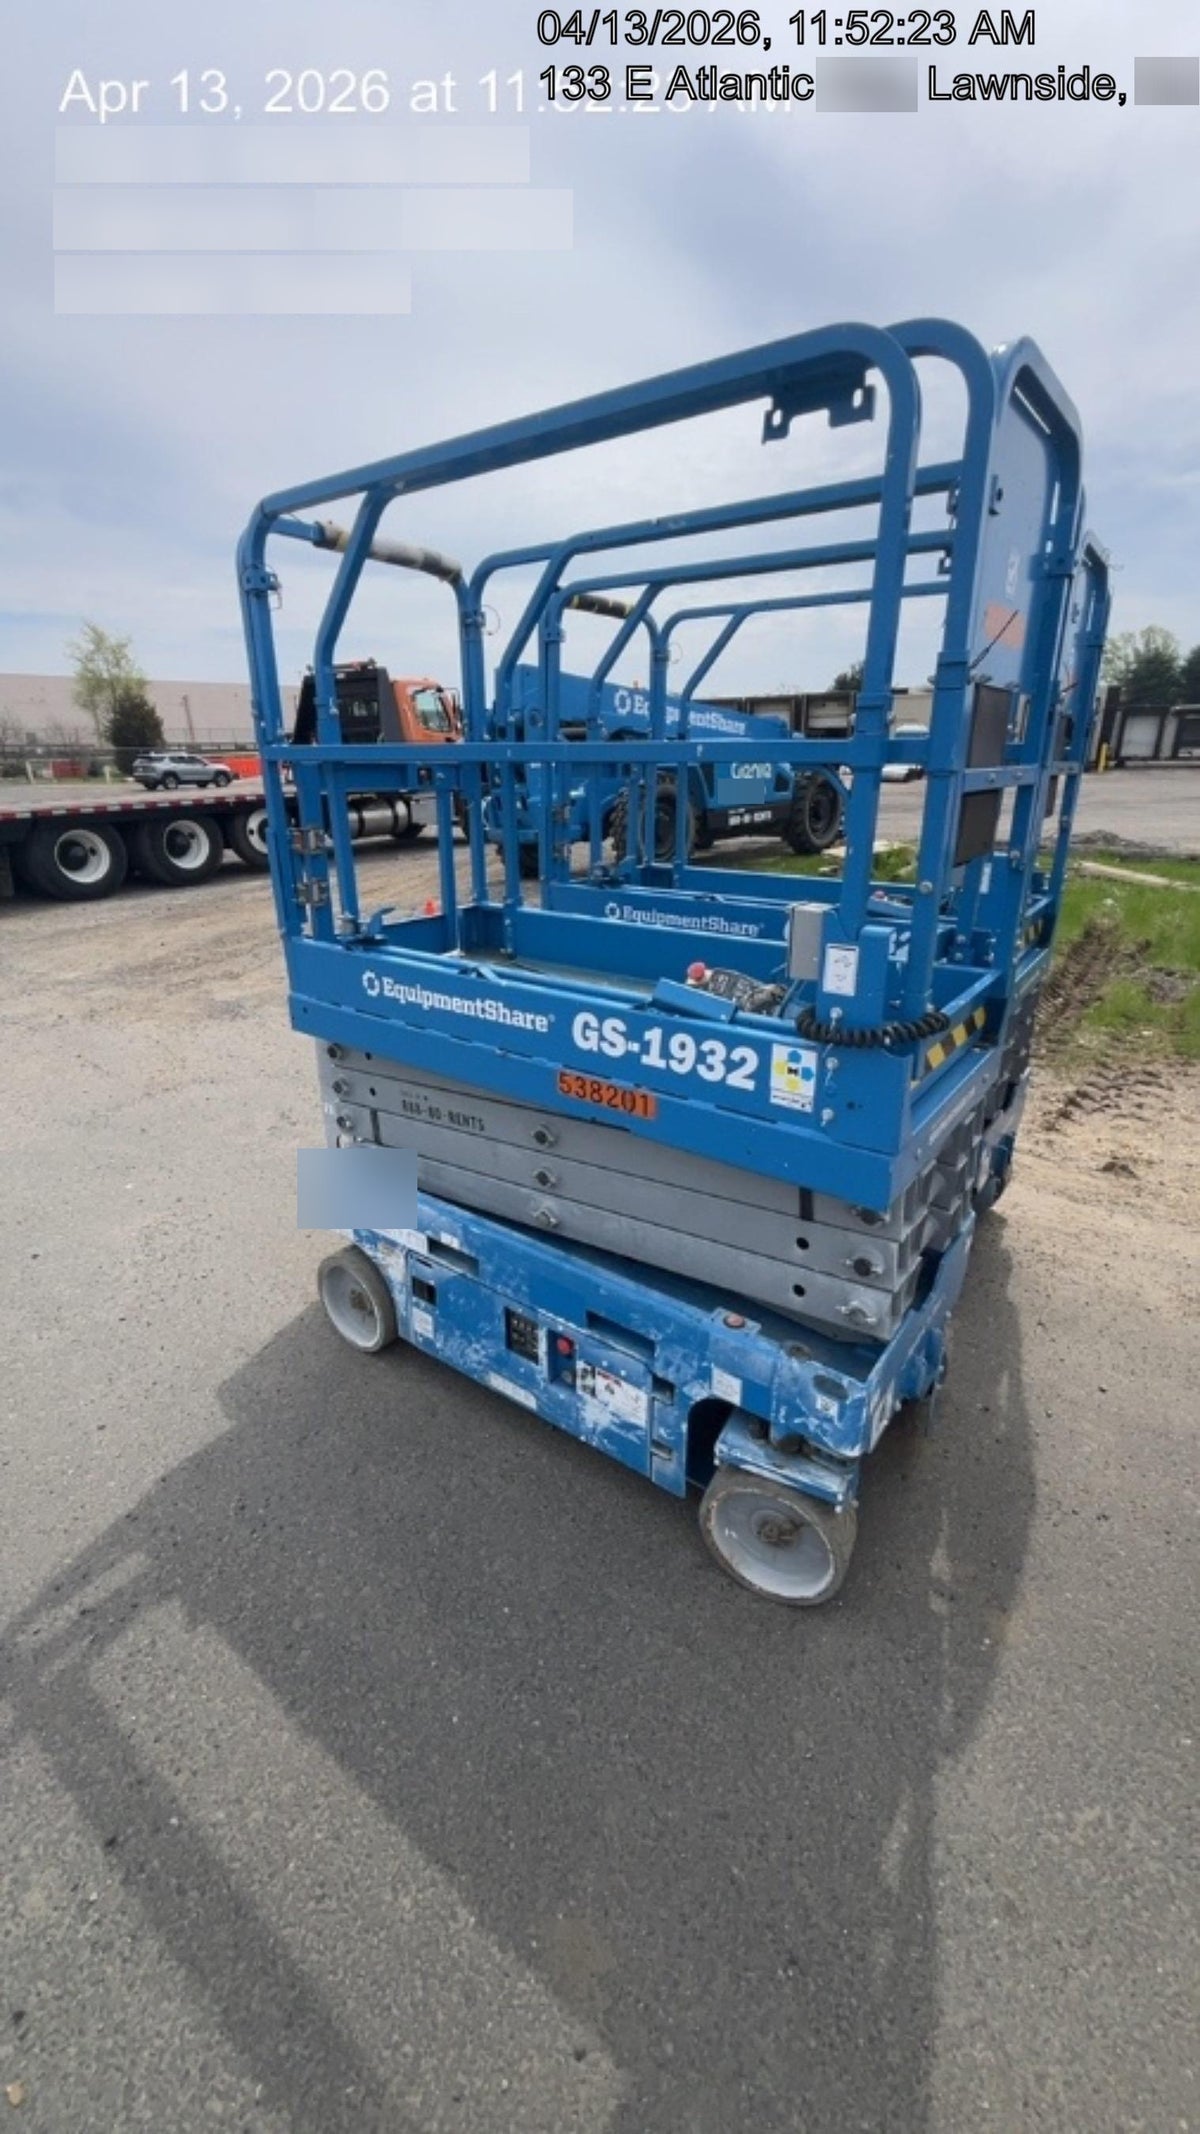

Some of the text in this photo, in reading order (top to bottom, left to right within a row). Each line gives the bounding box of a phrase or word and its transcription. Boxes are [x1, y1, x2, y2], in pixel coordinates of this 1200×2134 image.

[622, 905, 760, 937] EquipmentShare
[382, 976, 550, 1033] EquipmentShare
[571, 1011, 760, 1092] GS-1932
[558, 1072, 650, 1119] 538201
